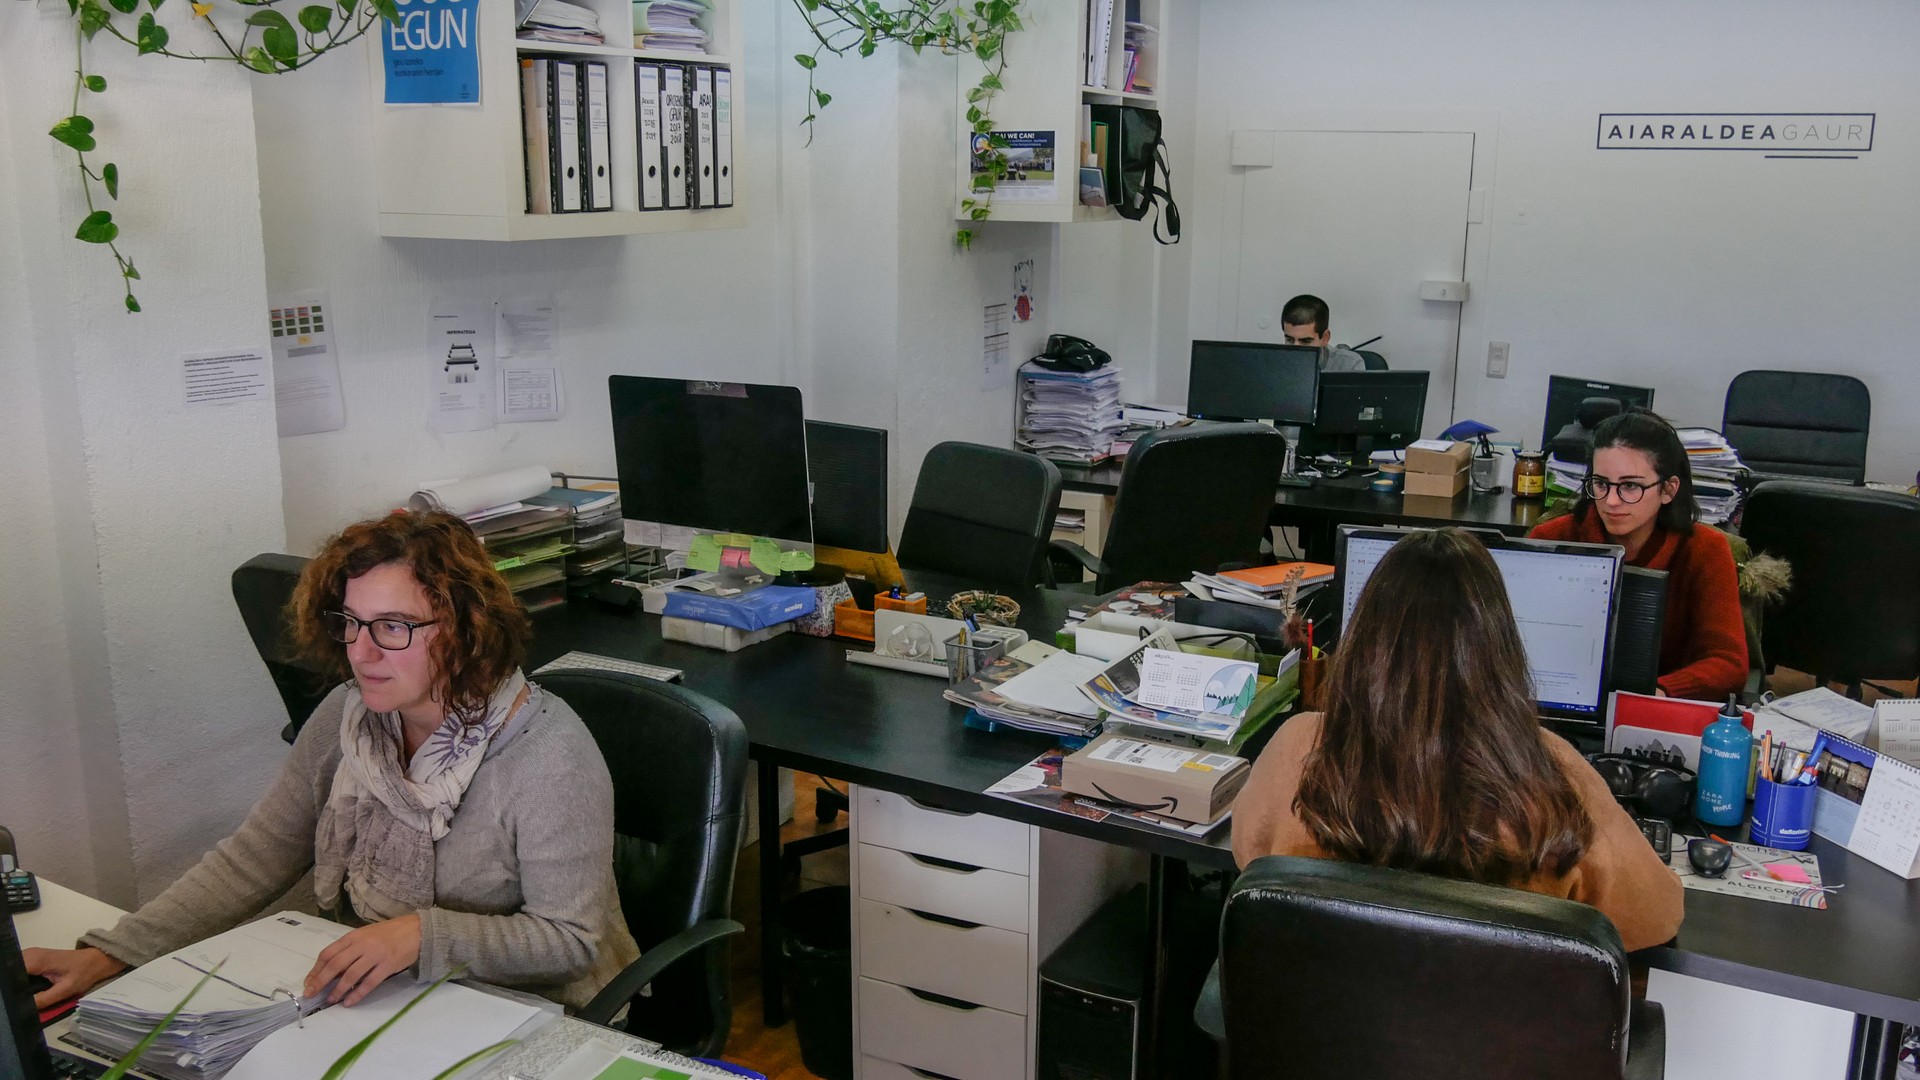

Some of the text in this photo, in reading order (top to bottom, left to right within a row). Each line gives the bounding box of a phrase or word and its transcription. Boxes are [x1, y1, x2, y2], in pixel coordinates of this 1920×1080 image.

[391, 8, 467, 51] EGUN
[1702, 790, 1722, 799] ZARA
[1701, 796, 1722, 805] HOME
[1713, 804, 1732, 813] PEOPLE
[1727, 880, 1800, 896] ALGICOM
